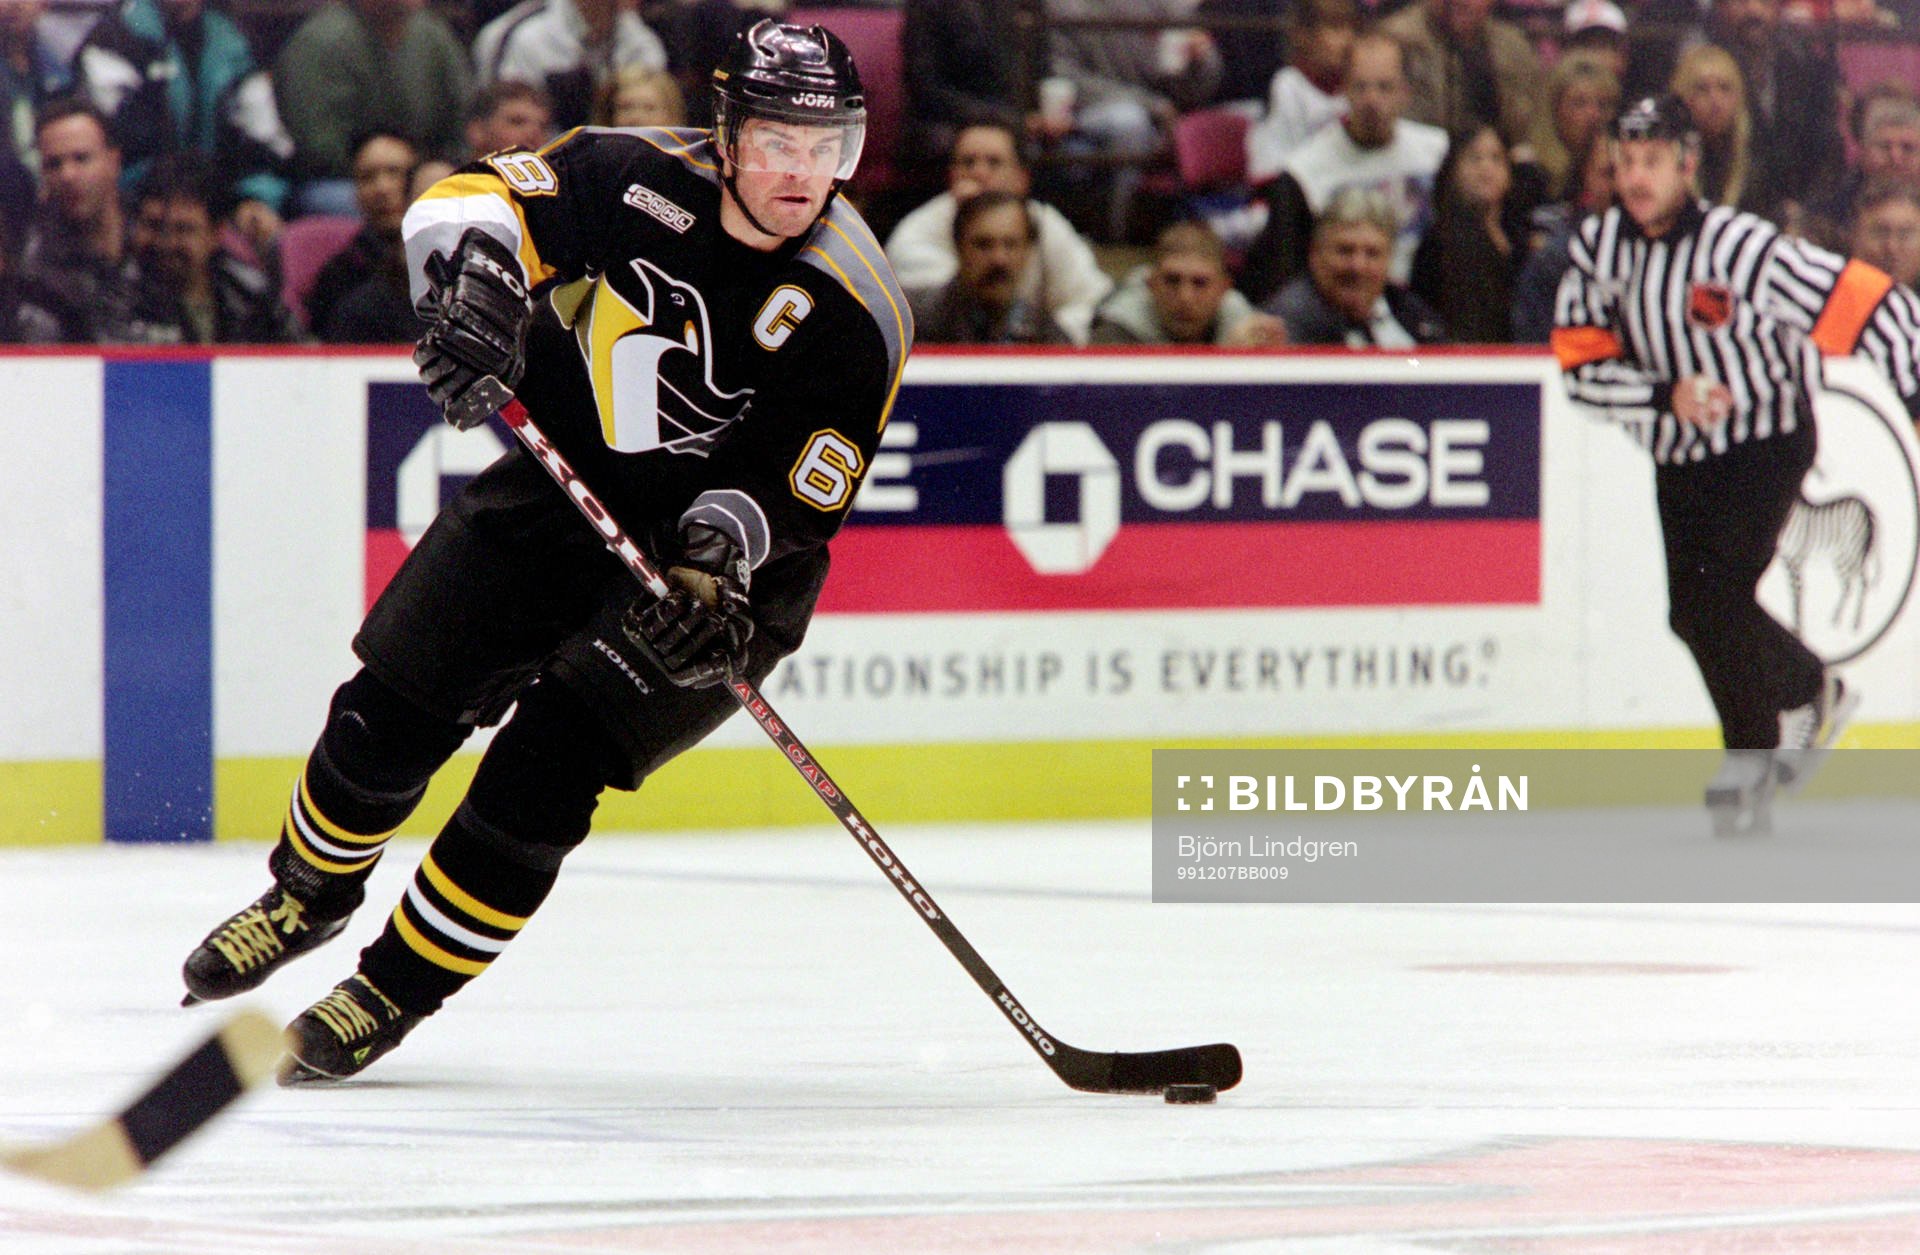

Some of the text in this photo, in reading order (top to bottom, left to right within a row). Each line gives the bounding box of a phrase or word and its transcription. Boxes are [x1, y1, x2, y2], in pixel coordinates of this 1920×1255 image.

[791, 92, 836, 109] JOFA
[751, 284, 816, 352] C
[788, 427, 865, 513] 6
[1134, 418, 1490, 511] CHASE
[518, 418, 670, 599] KOH
[592, 638, 650, 695] KOHO
[778, 651, 1064, 699] ATIONSHIP
[1087, 648, 1134, 694] IS
[734, 683, 837, 798] ABS CAP
[845, 812, 938, 920] KOHO
[997, 991, 1056, 1057] KOHO
